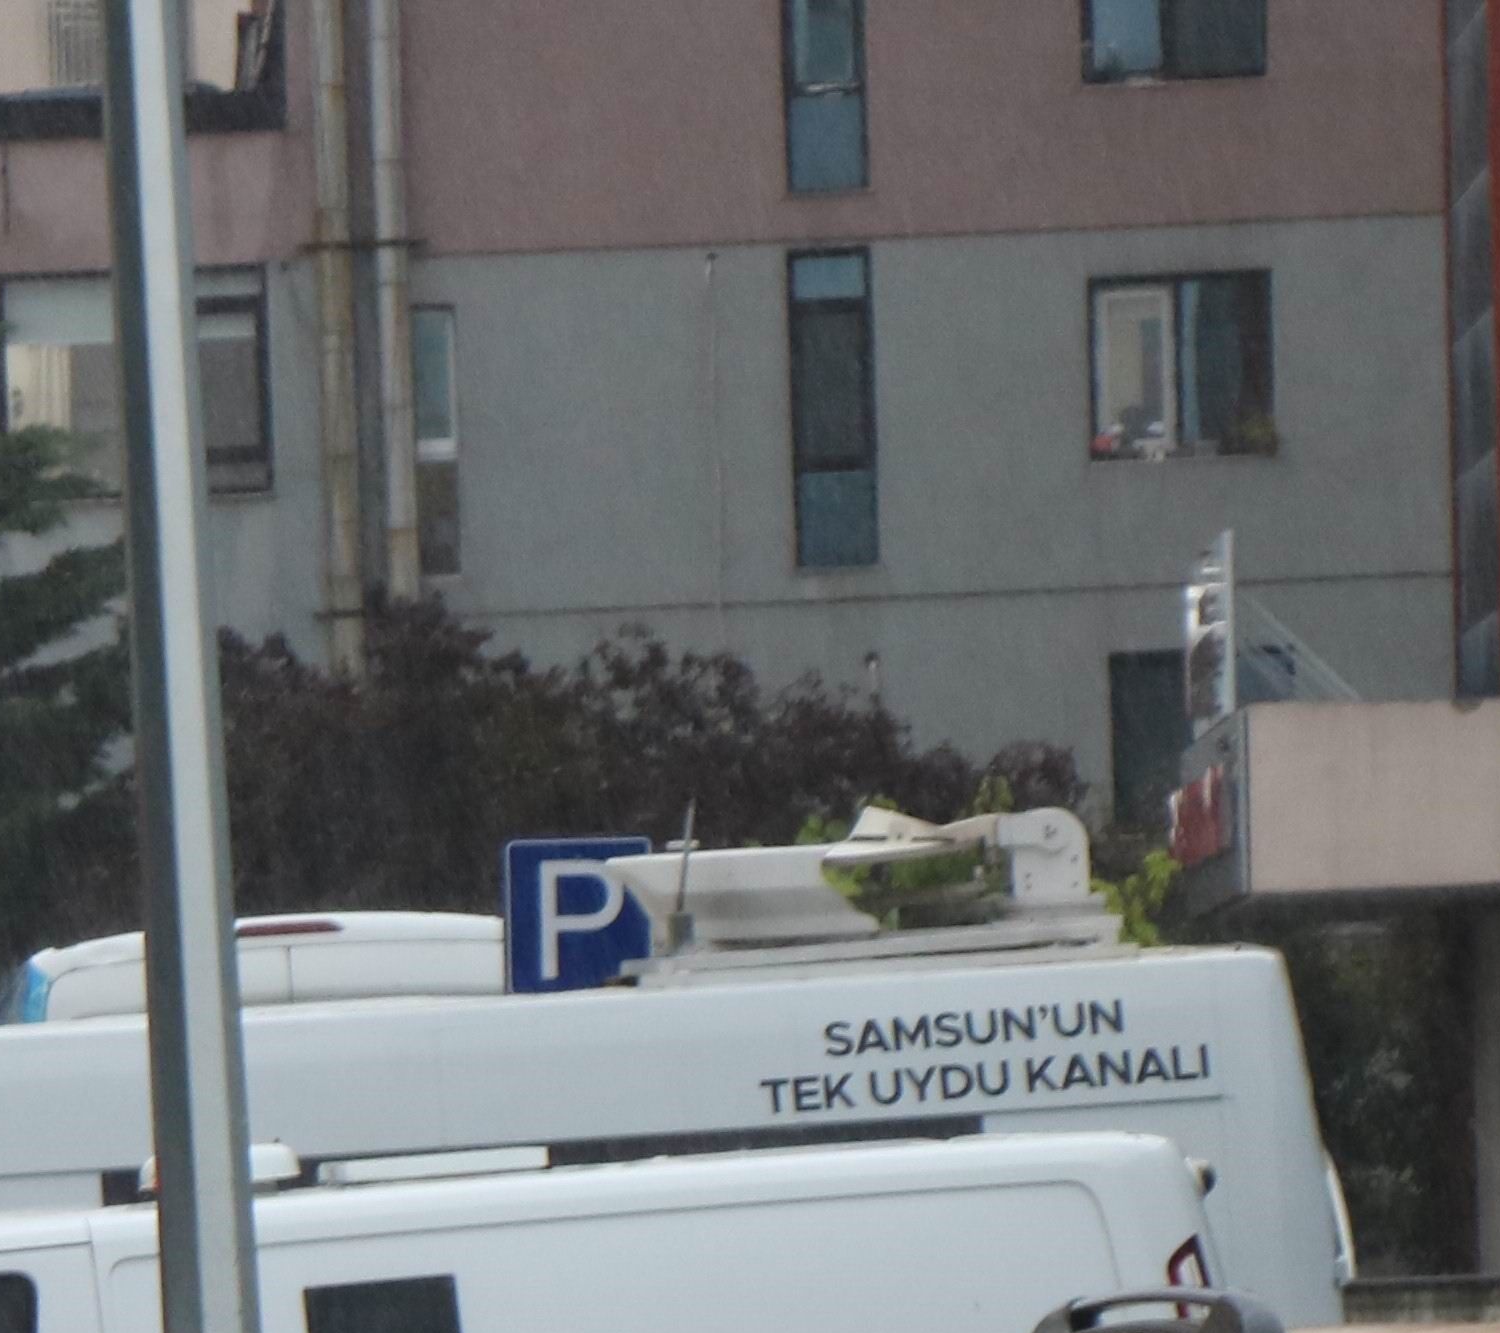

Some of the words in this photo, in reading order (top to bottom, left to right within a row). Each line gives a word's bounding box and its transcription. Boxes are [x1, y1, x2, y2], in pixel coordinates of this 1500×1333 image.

[539, 859, 625, 981] P
[823, 999, 1125, 1057] SAMSUN'UN
[760, 1073, 856, 1115] TEK
[869, 1059, 1012, 1107] UYDU
[1025, 1043, 1210, 1094] KANALI
